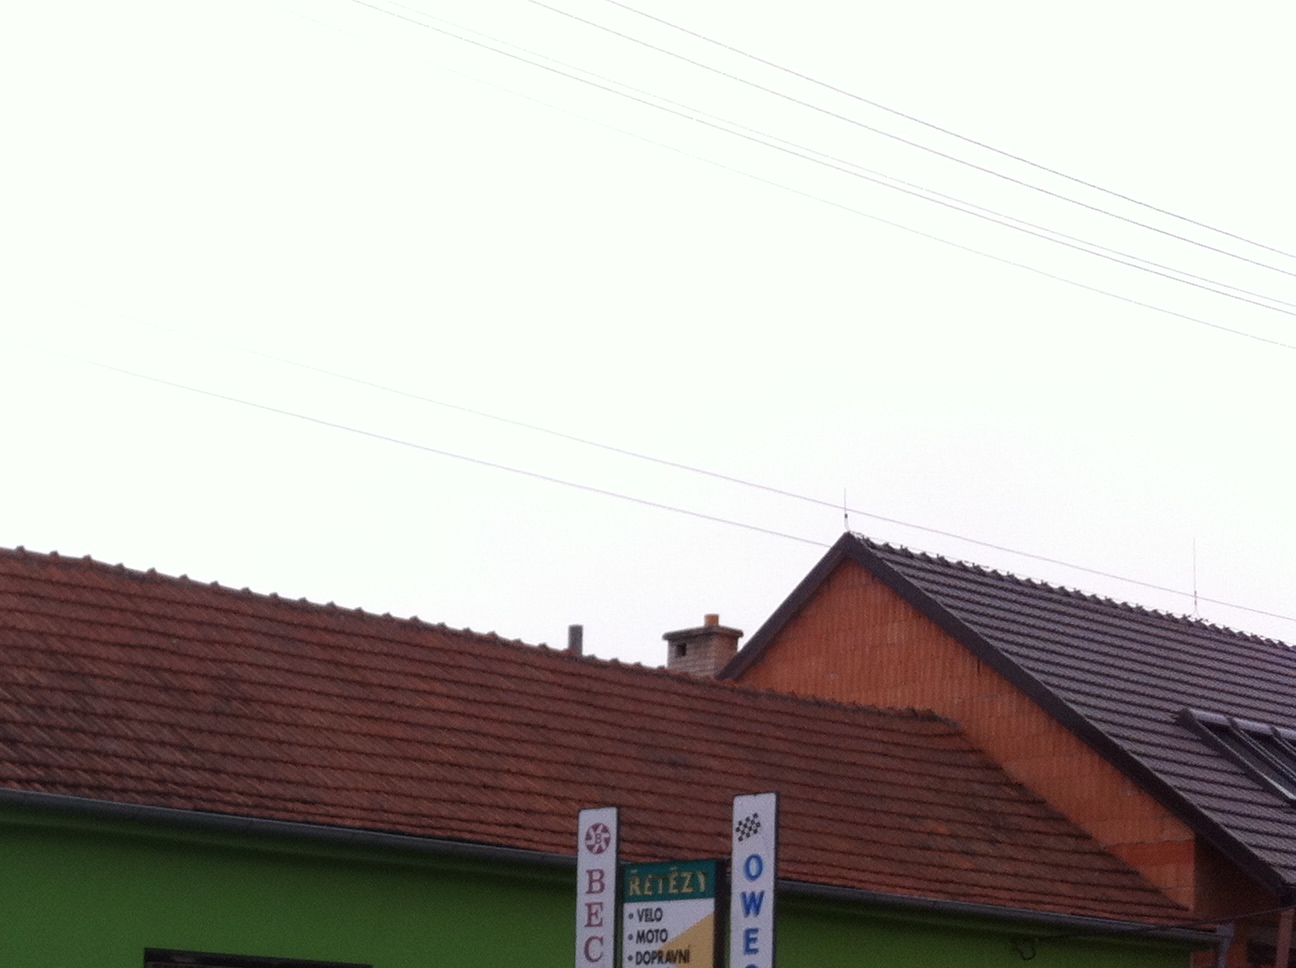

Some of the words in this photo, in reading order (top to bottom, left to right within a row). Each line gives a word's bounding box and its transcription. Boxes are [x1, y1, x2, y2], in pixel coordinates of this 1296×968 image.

[629, 866, 707, 896] ŘETĚZY
[637, 907, 663, 922] VELO
[636, 929, 668, 944] MOTO
[635, 945, 690, 965] DOPRAVNÍ
